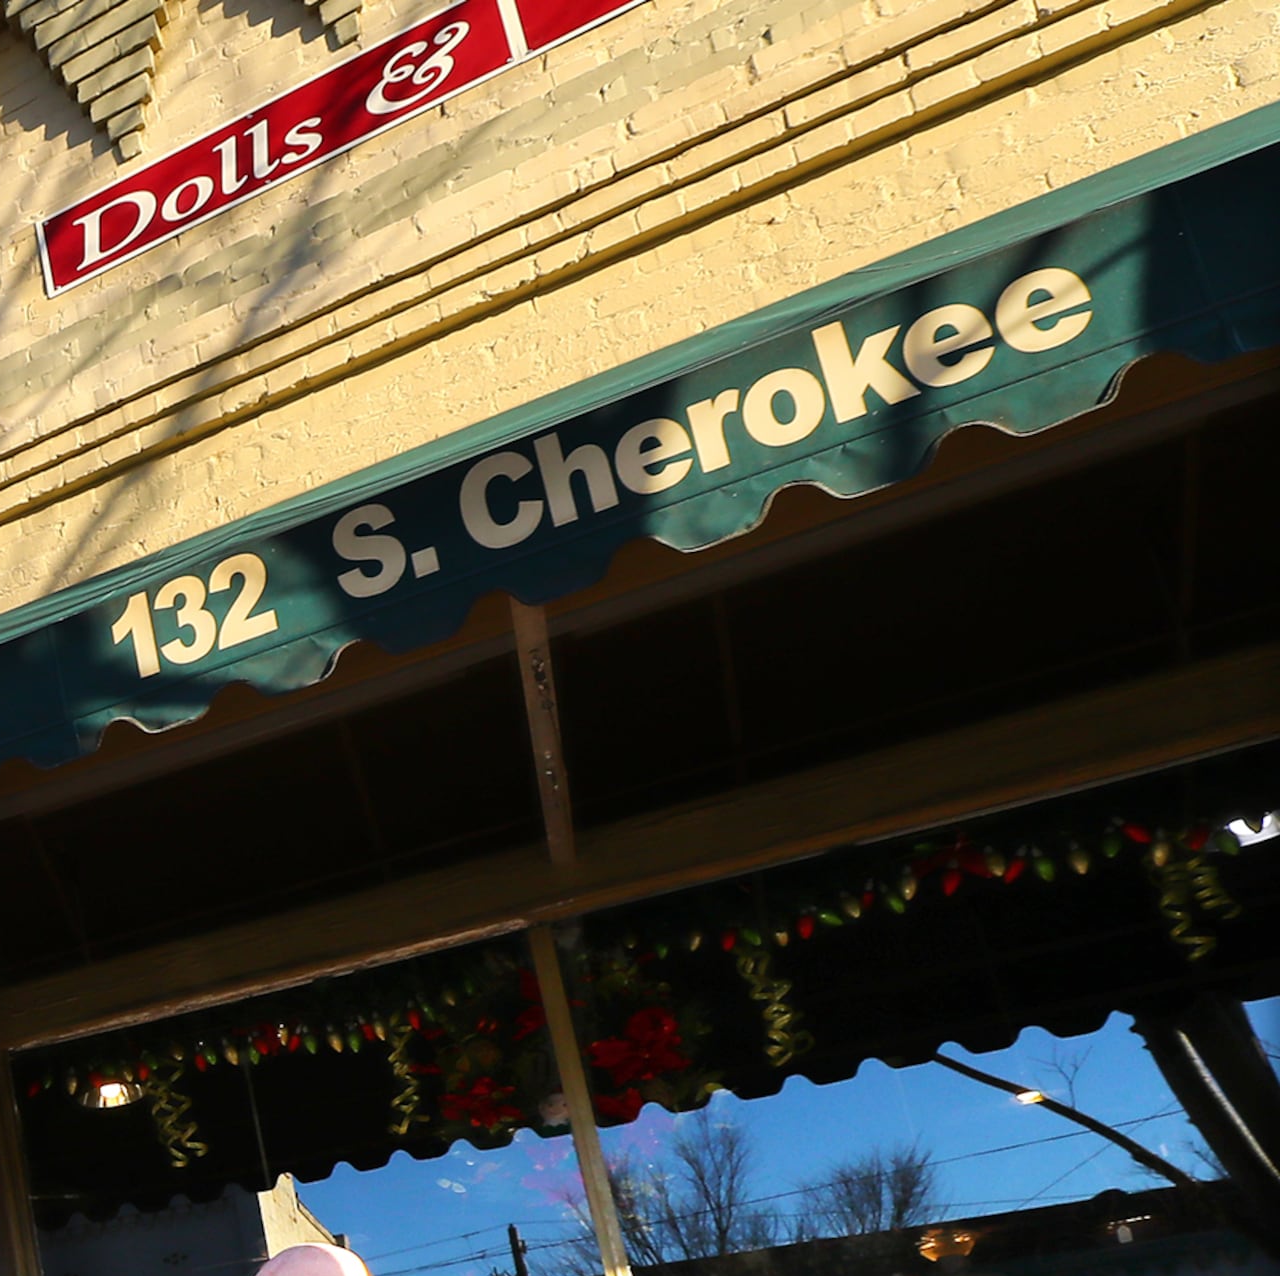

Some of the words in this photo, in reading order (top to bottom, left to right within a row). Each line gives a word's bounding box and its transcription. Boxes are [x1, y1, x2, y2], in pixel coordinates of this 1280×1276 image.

[73, 117, 323, 272] Dolls
[365, 20, 470, 115] &
[111, 553, 279, 678] 132
[332, 504, 439, 598] S.
[458, 265, 1093, 549] Cherokee
